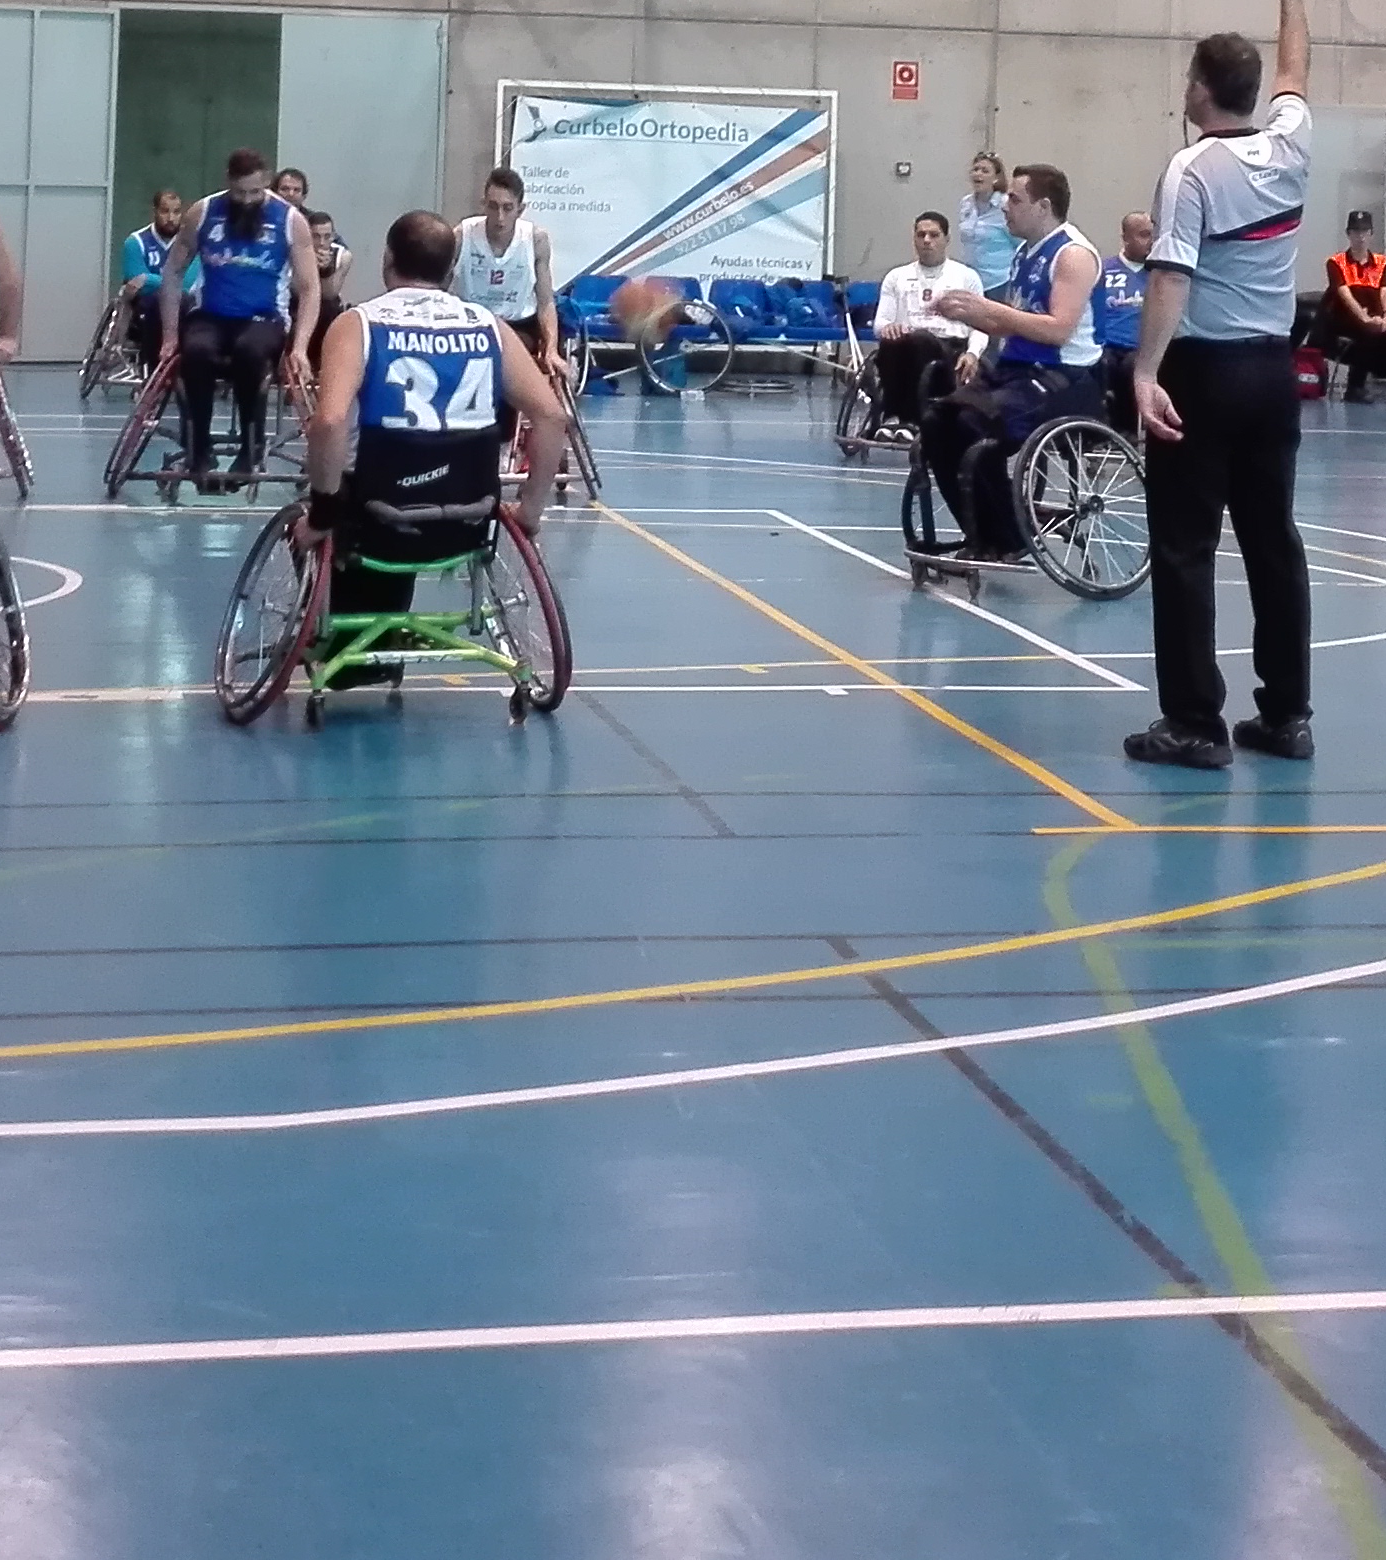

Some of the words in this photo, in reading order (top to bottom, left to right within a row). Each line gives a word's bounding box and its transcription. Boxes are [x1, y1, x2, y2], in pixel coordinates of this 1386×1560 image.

[522, 166, 552, 178] Taller
[555, 167, 569, 178] de
[523, 184, 584, 195] abricación
[526, 201, 558, 214] ropia
[559, 203, 566, 212] a
[568, 201, 611, 212] medida
[663, 182, 754, 239] www.curbelo.es
[711, 255, 753, 268] Ayudas
[756, 255, 803, 269] técnicas
[806, 260, 812, 270] y
[490, 269, 505, 285] 12
[922, 288, 933, 302] 8
[387, 331, 489, 354] MANOLITO
[380, 356, 497, 431] 34
[401, 464, 450, 487] QUICKIE
